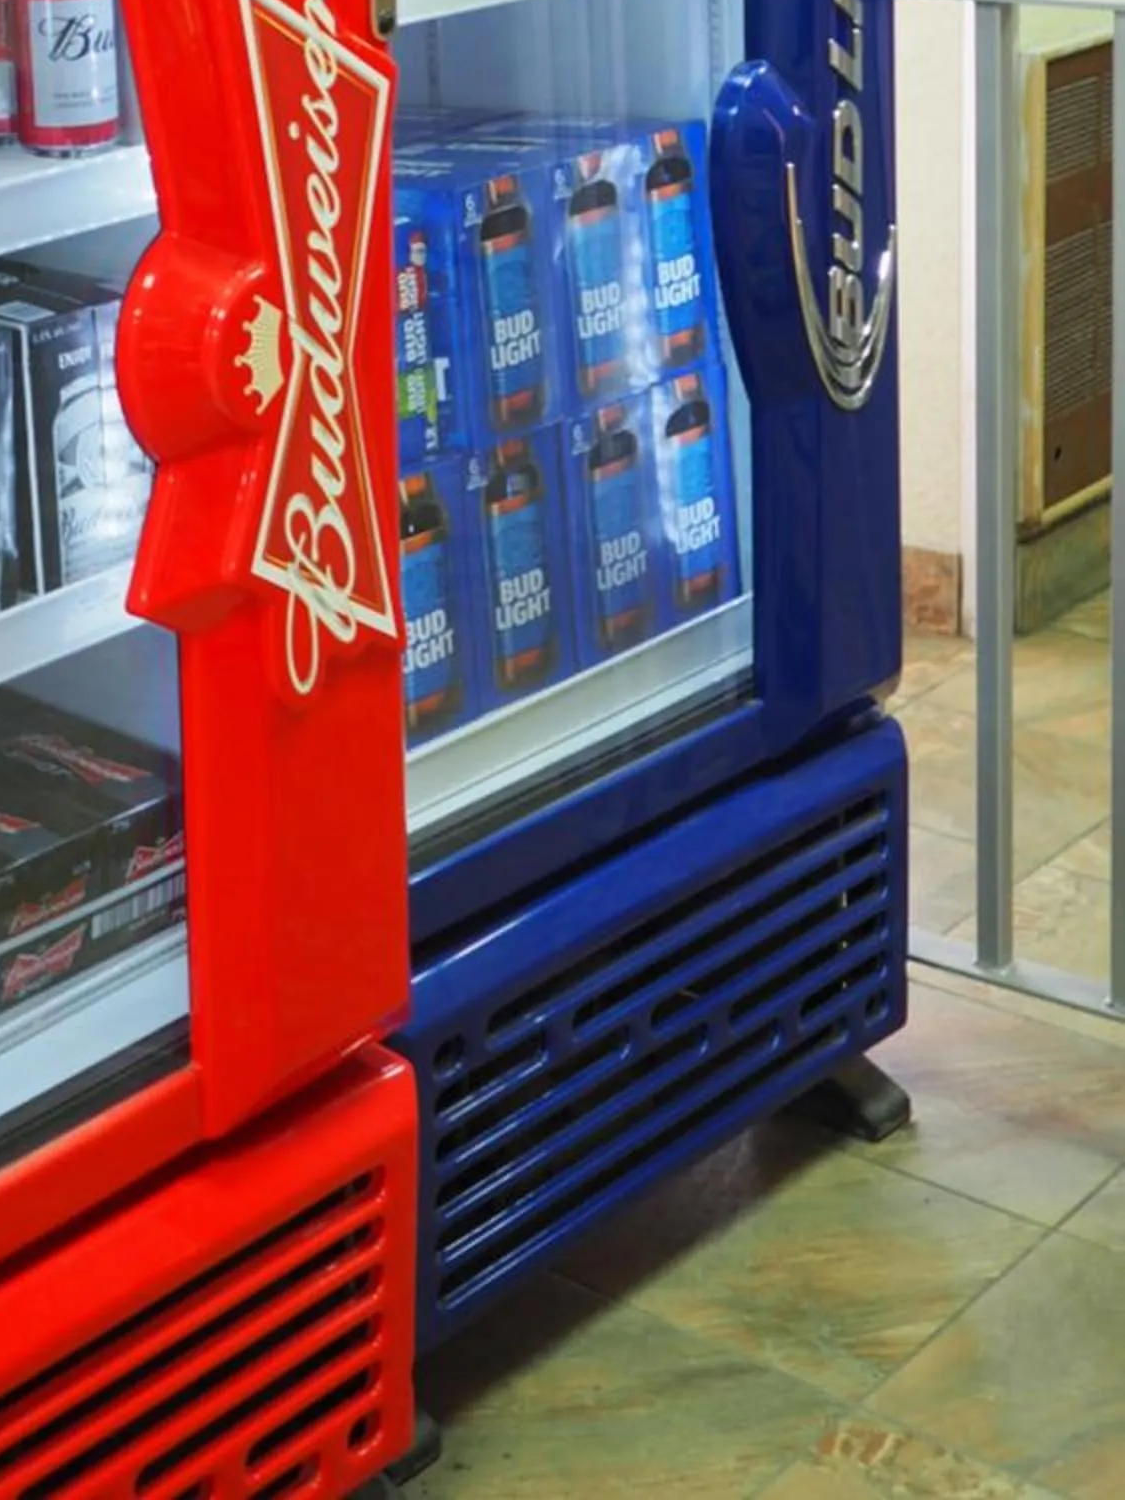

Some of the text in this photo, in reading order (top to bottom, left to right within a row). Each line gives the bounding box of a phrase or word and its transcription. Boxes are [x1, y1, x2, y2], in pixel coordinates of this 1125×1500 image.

[829, 101, 866, 346] BUD
[657, 254, 695, 285] BUD
[582, 282, 621, 315] BUD
[655, 273, 701, 310] LIGHT
[494, 309, 535, 344] BUD
[578, 301, 628, 340] LIGHT
[57, 345, 93, 370] ENJOY
[491, 329, 542, 371] LIGHT
[678, 496, 715, 530] BUD
[600, 531, 642, 567] BUD
[677, 515, 721, 555] LIGHT
[499, 568, 545, 606] BUD
[596, 551, 648, 591] LIGHT
[406, 608, 447, 646] BUD
[495, 587, 552, 631] LIGHT
[402, 629, 456, 675] LIGHT
